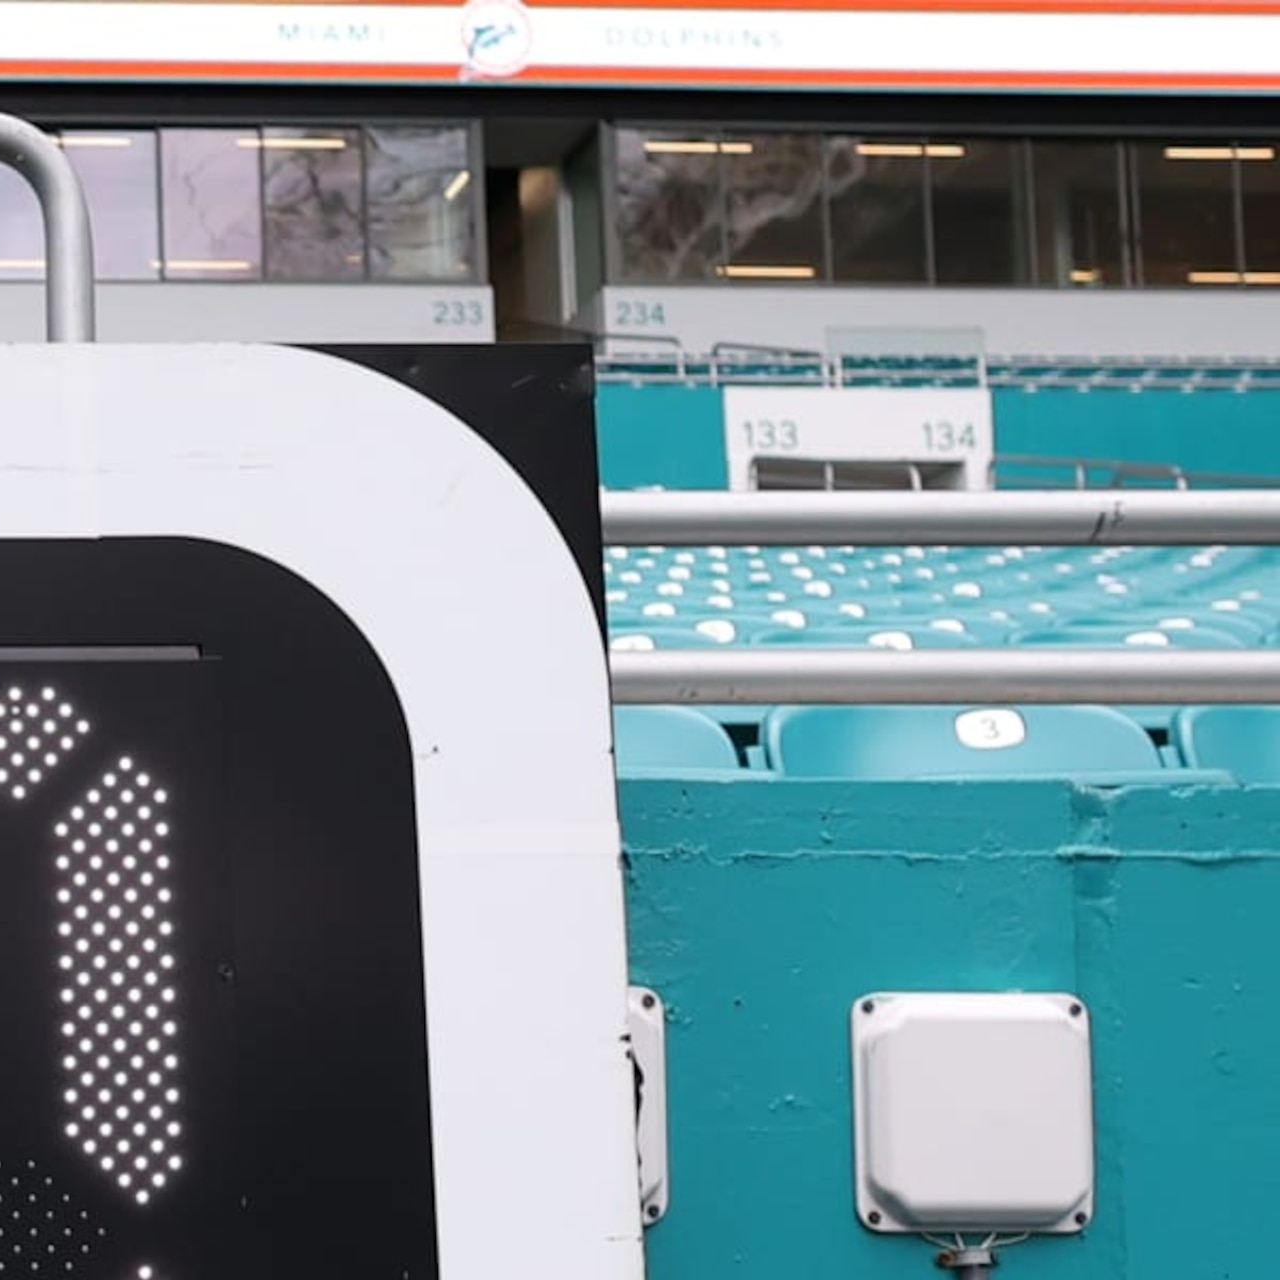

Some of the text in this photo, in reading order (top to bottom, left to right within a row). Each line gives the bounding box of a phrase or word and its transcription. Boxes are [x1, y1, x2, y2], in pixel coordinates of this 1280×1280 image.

[276, 22, 386, 43] MIAMI
[605, 25, 783, 48] DOLPHINS
[433, 301, 483, 325] 233
[615, 301, 666, 326] 234
[743, 420, 799, 450] 133
[922, 422, 977, 451] 134
[980, 716, 1001, 740] 3
